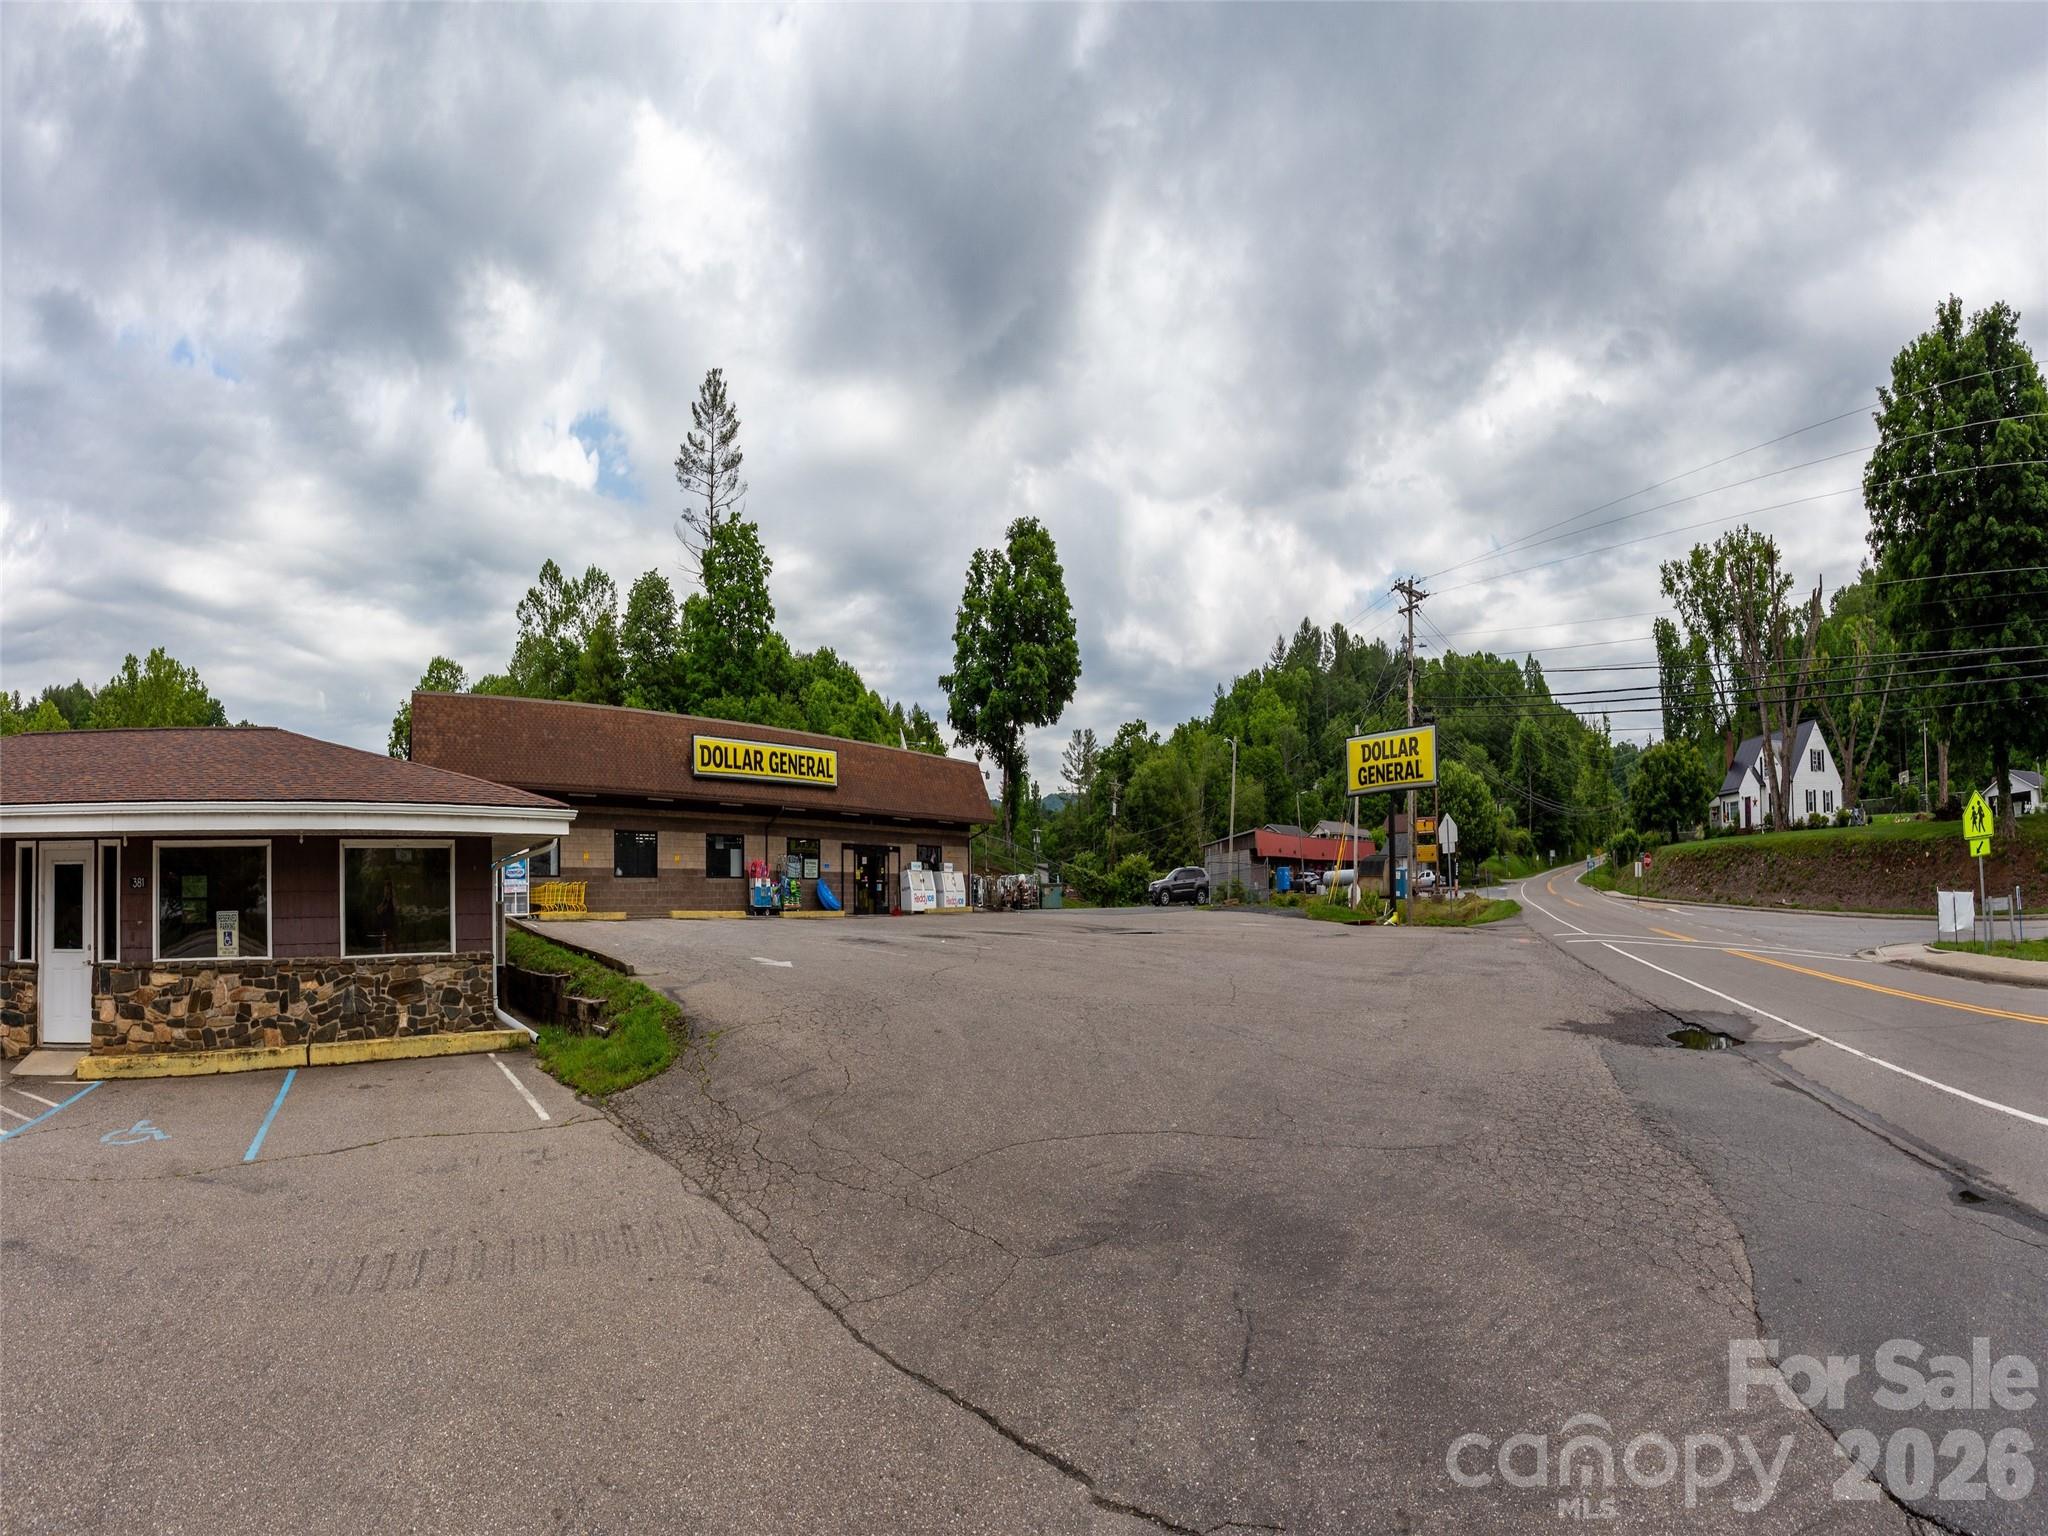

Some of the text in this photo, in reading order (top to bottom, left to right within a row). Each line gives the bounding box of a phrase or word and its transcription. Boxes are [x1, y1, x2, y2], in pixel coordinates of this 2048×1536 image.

[699, 744, 834, 778] DOLLAR GENERAL
[1361, 736, 1419, 763] DOLLAR
[1358, 759, 1424, 785] GENERAL
[132, 877, 145, 888] 381
